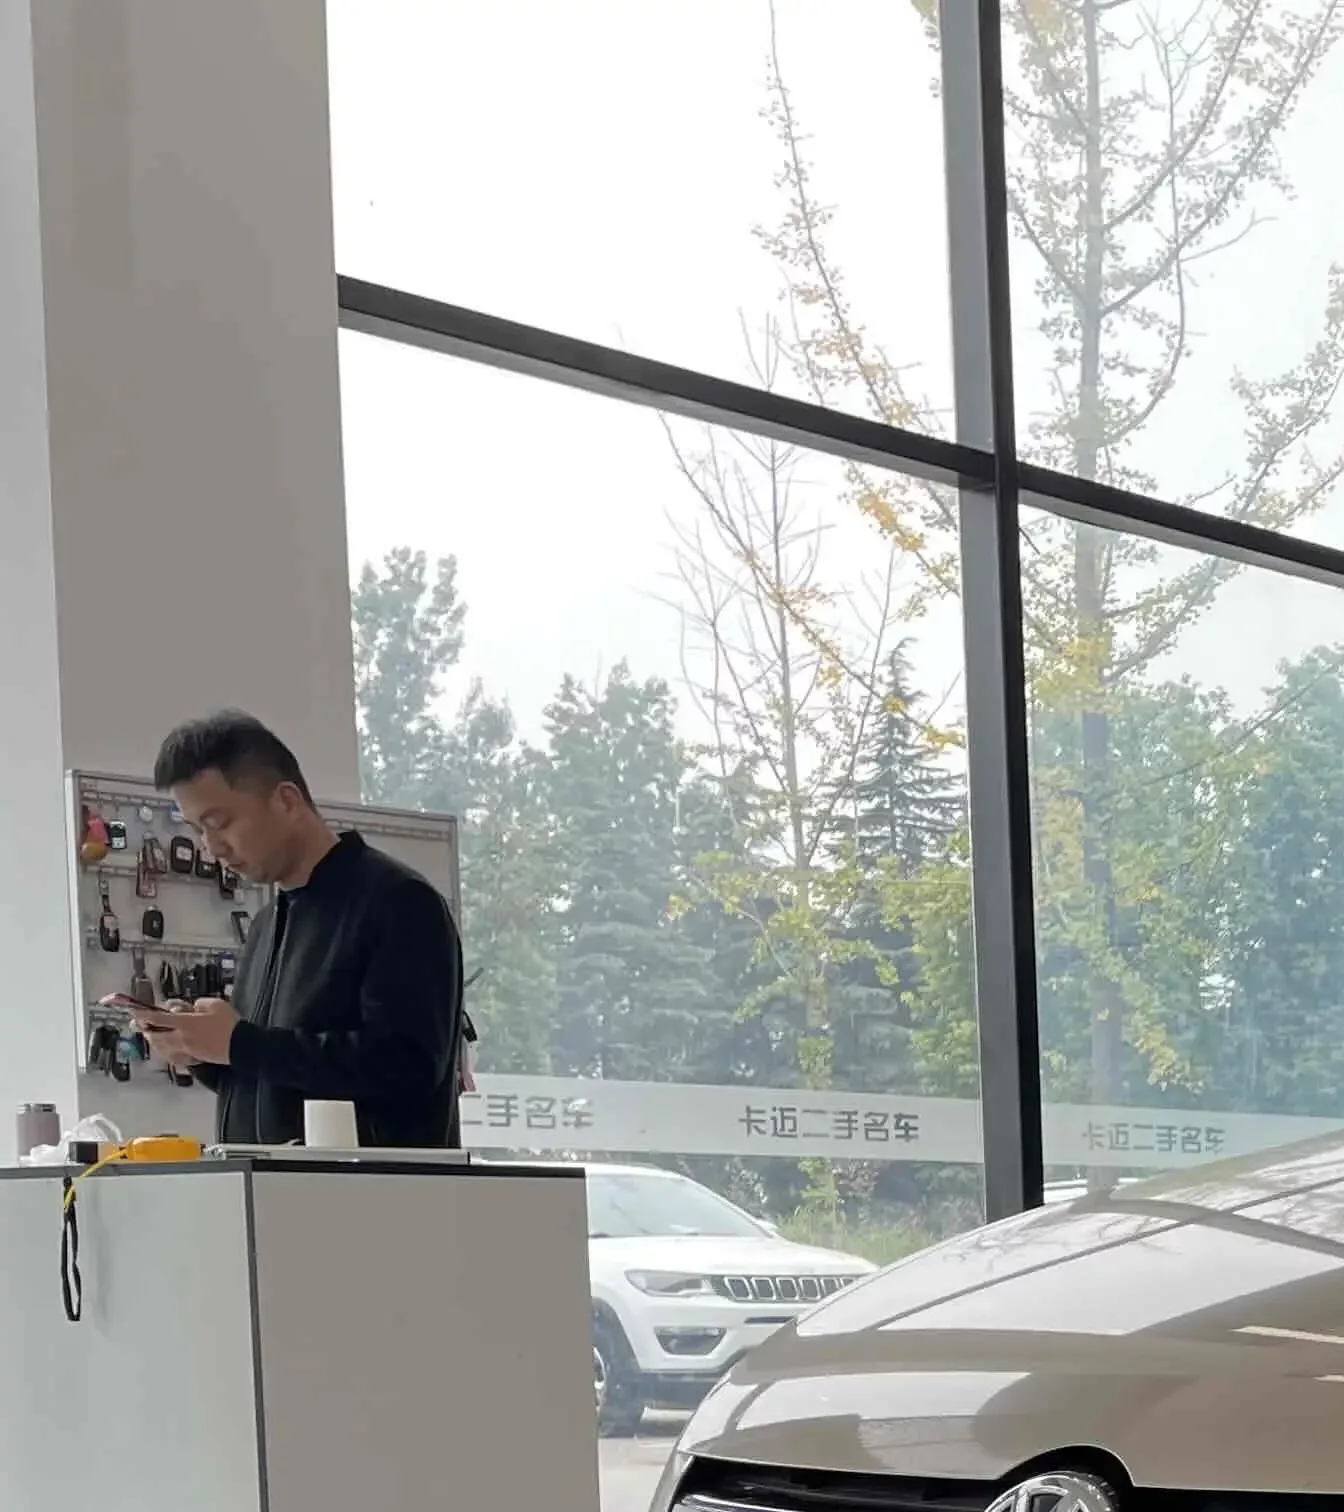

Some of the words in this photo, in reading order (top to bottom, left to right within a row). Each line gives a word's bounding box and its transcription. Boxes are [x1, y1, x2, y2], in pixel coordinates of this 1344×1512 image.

[738, 1105, 919, 1143] 卡迈二手名车
[1082, 1121, 1225, 1155] 卡迈二手名车
